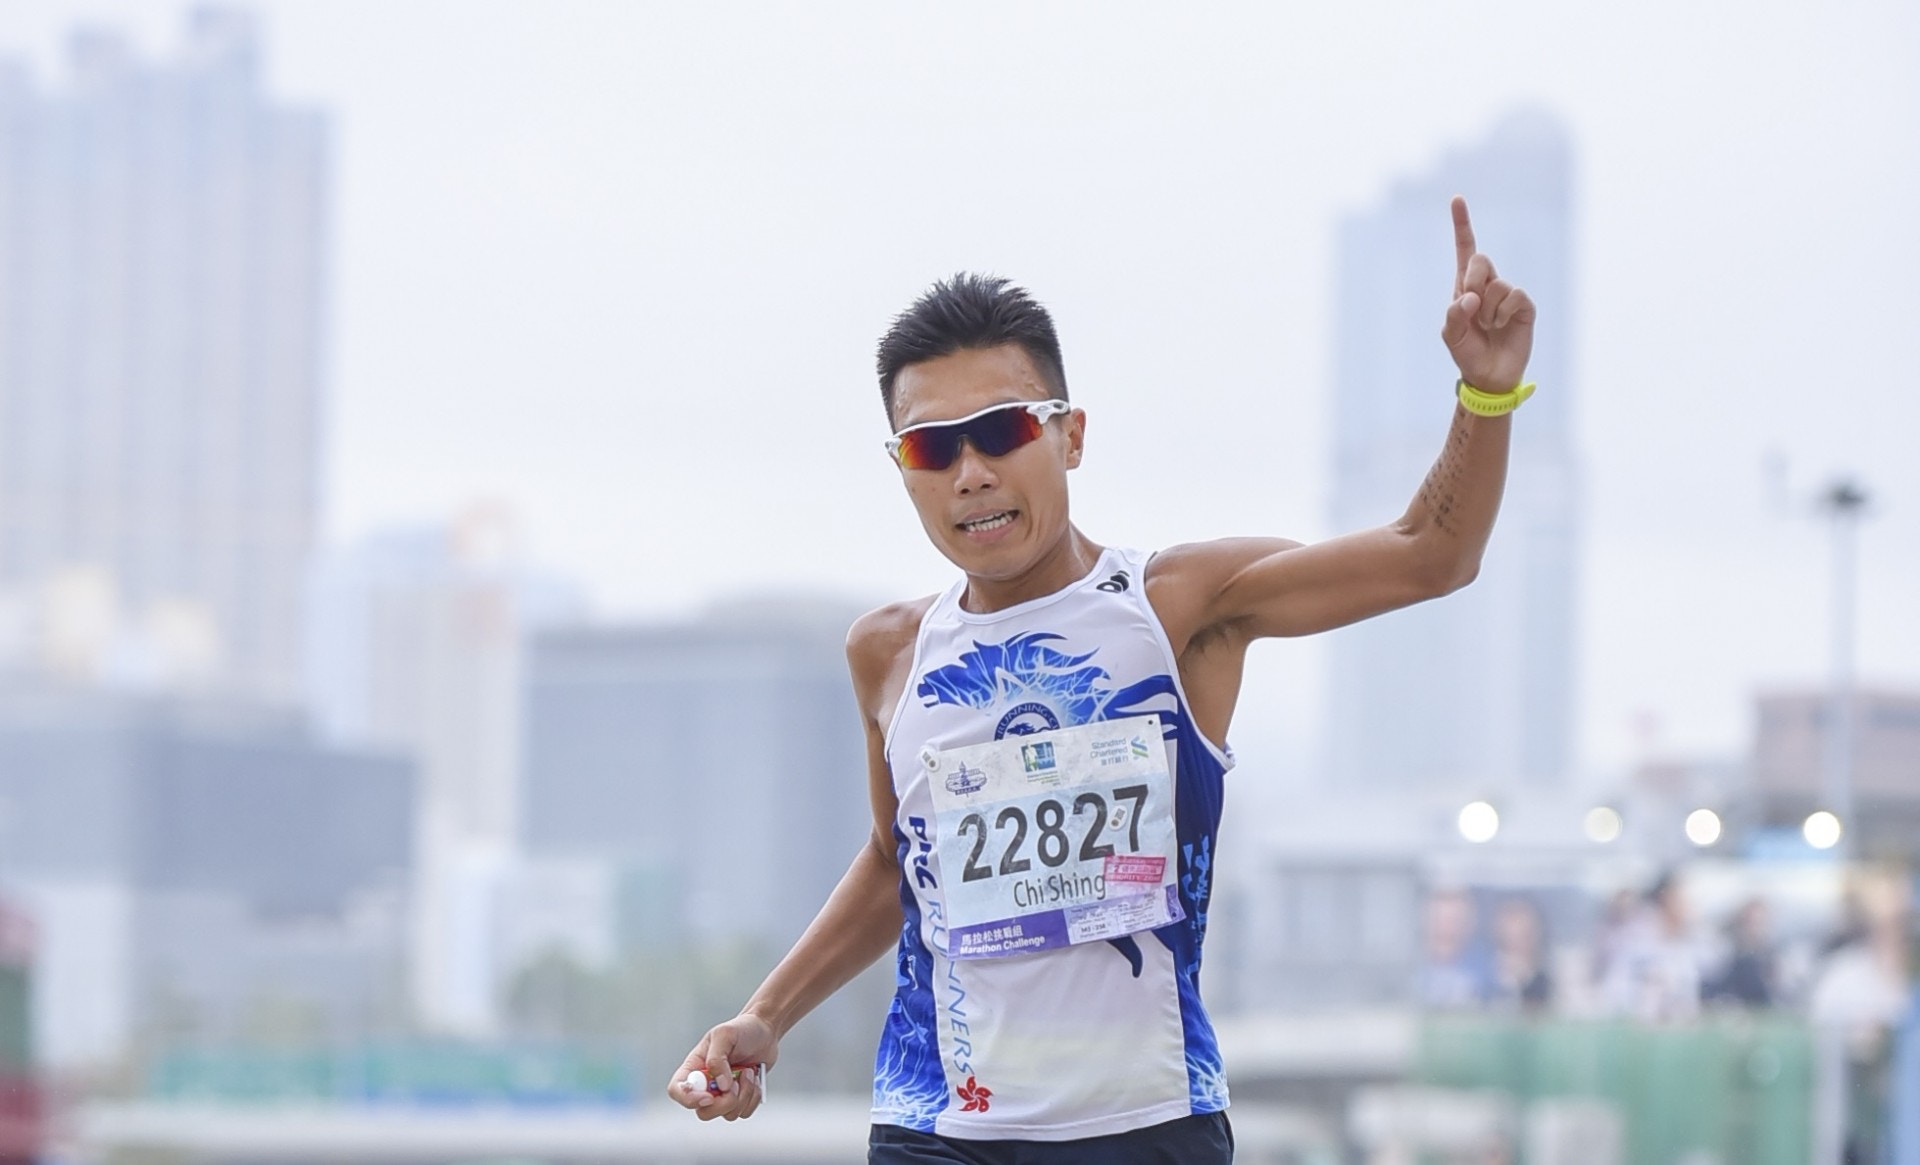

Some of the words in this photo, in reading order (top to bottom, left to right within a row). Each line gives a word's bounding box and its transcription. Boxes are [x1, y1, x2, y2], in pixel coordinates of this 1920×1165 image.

[957, 784, 1149, 883] 22827
[1013, 875, 1044, 908] Chi
[1047, 872, 1106, 902] Shing
[959, 942, 1002, 955] Marathon
[1003, 935, 1046, 952] Challenge
